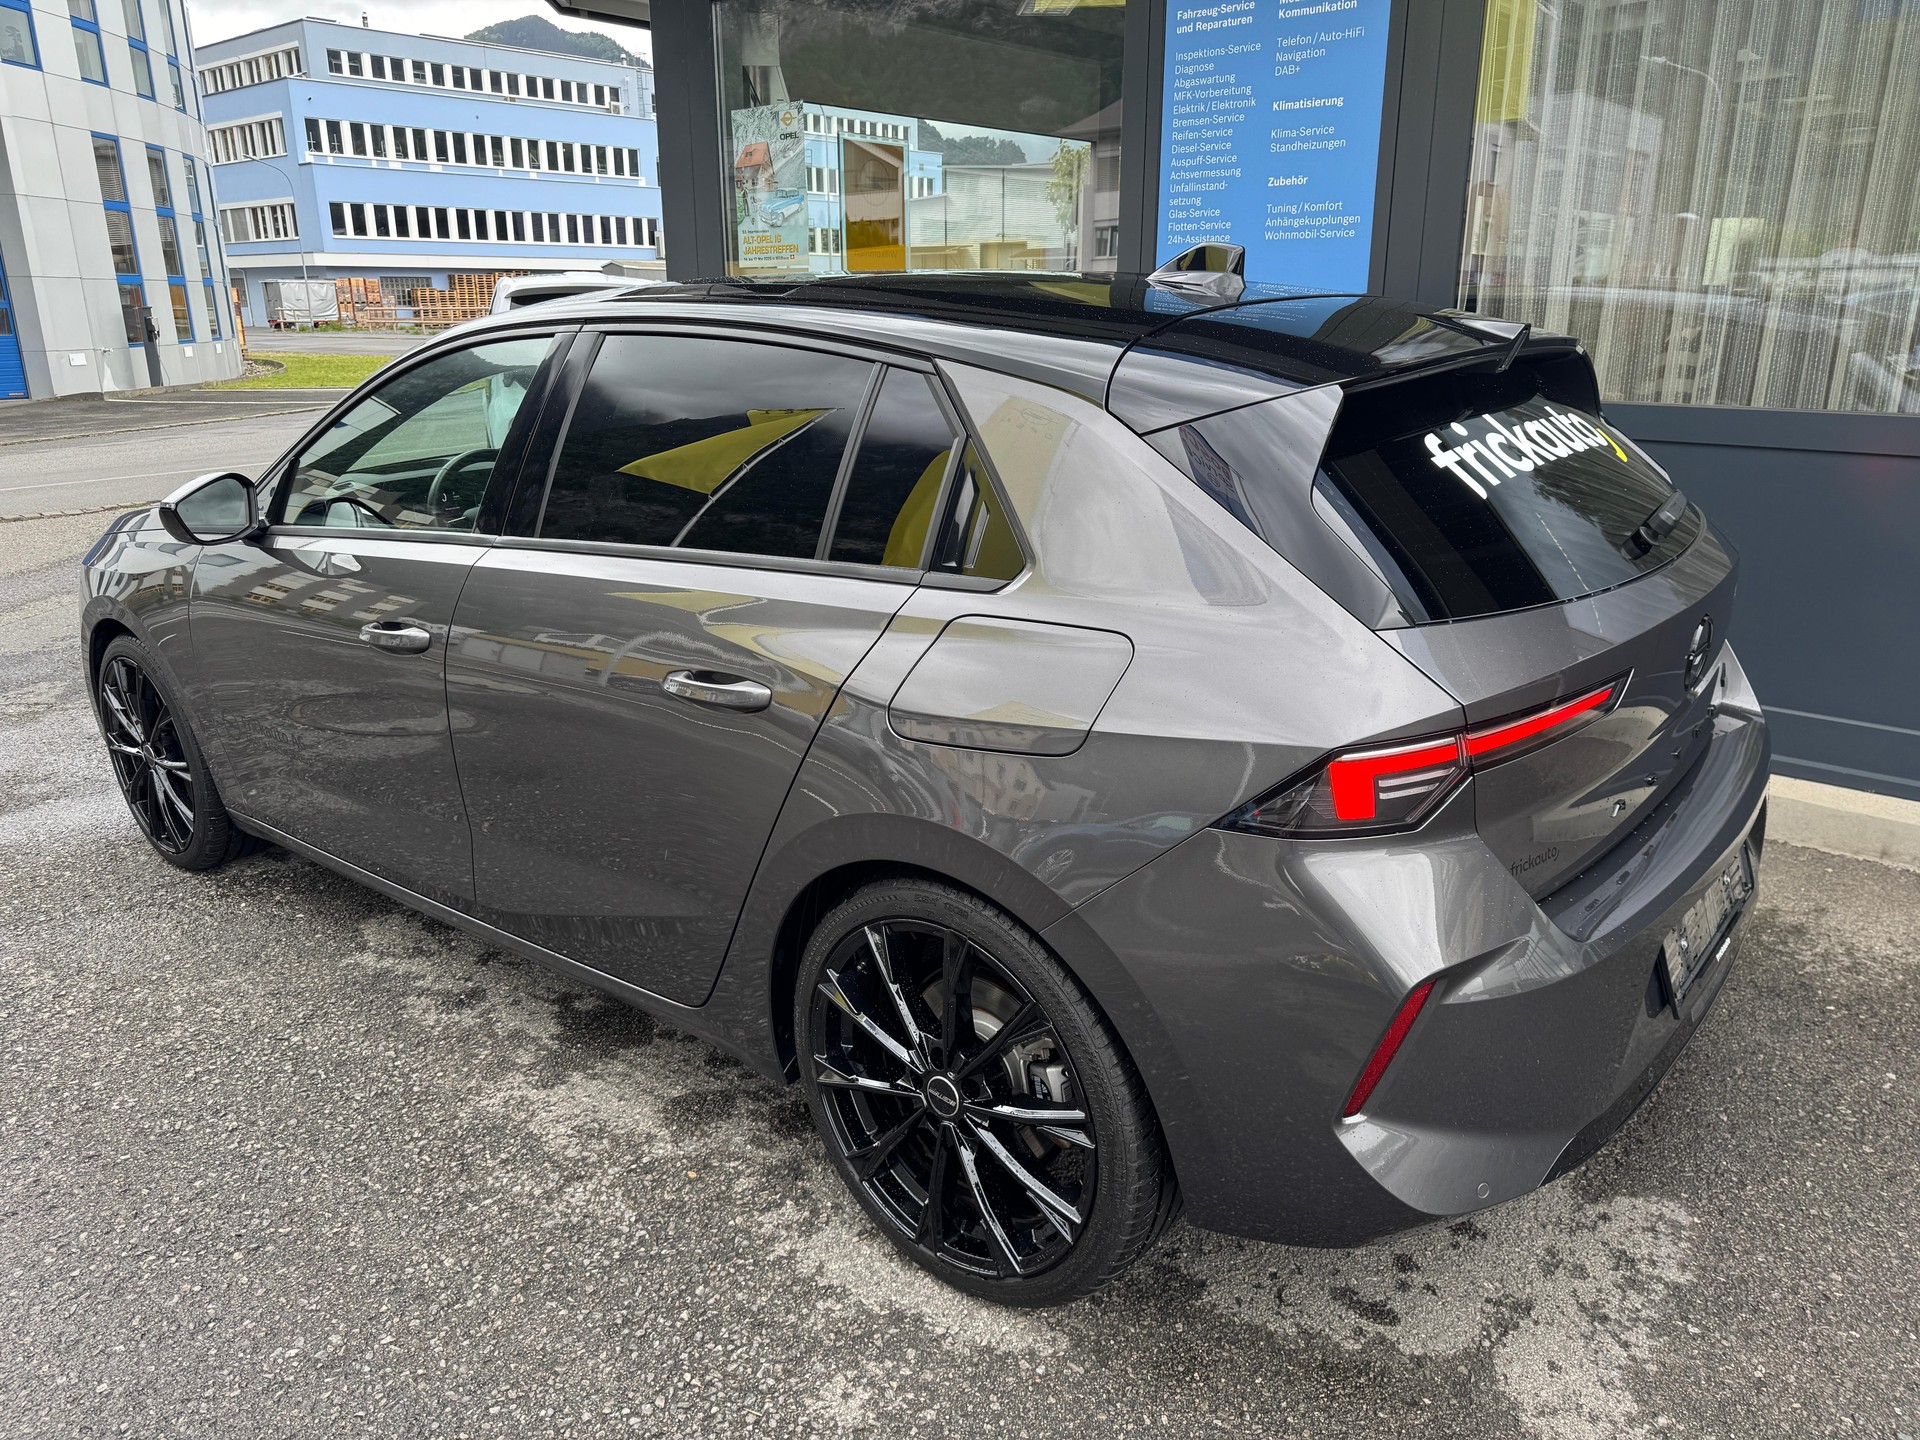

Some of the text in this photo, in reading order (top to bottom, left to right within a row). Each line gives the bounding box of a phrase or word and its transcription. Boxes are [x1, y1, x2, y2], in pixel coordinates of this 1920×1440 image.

[1177, 1, 1255, 21] Fahrzeug-Service
[1278, 0, 1358, 19] Kommunikation
[1176, 15, 1253, 34] und Reparaturen
[1277, 34, 1312, 48] Telefon
[1319, 26, 1365, 42] Auto-HiFi
[1175, 42, 1261, 61] Inspektions-Service
[1275, 48, 1326, 62] Navigation
[1174, 62, 1215, 75] Diagnose
[1275, 66, 1301, 76] DAB+
[1174, 73, 1236, 88] Abgaswartung
[1173, 85, 1252, 101] MFK-Vorbereitung
[1272, 96, 1344, 111] Klimatisierung
[1172, 113, 1245, 128] Bremsen-Service
[780, 132, 799, 140] OPEL
[1172, 127, 1233, 141] Reifen-Service
[1271, 125, 1335, 139] Klima-Service
[1171, 141, 1232, 154] Diesel-Service
[1270, 138, 1346, 153] Standheizungen
[1170, 154, 1238, 168] Auspuff-Service
[1170, 167, 1242, 180] Achsvermessung
[1268, 174, 1308, 187] Zubehör
[1169, 180, 1228, 193] Unfallinstand-
[1169, 196, 1202, 206] setzung
[1266, 203, 1297, 215] Tuning
[1304, 200, 1343, 212] Komfort
[1168, 208, 1221, 219] Glas-Service
[1168, 220, 1231, 232] Flotten-Service
[1265, 214, 1361, 228] Anhängekupplungen
[743, 234, 774, 244] ALT-OPEL
[1167, 233, 1230, 245] 24h-Assistance
[1264, 228, 1355, 241] Wohnmobil-Service
[743, 243, 799, 255] JAHRESTREFFEN
